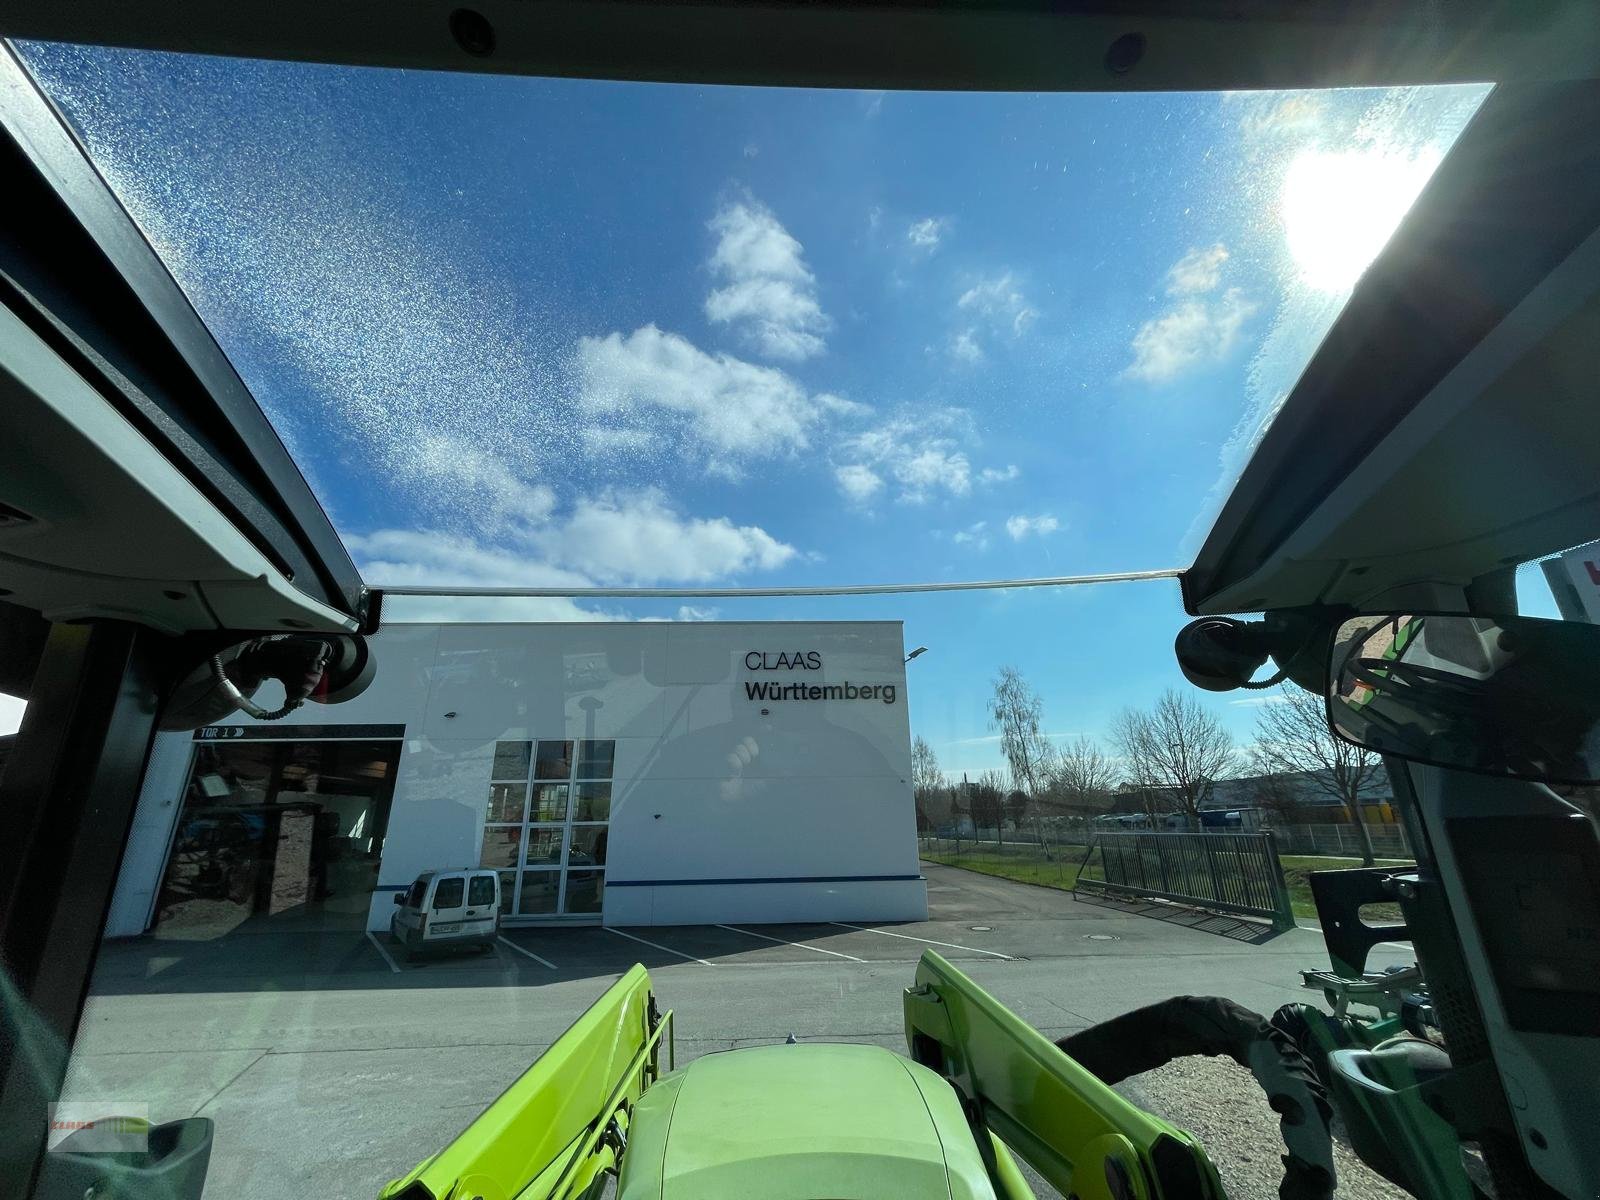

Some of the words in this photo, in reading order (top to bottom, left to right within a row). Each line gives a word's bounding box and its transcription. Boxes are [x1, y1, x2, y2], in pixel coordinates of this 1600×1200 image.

[745, 651, 822, 671] CLAAS
[745, 681, 896, 705] Württemberg
[201, 728, 219, 738] TOR
[223, 728, 229, 738] 1
